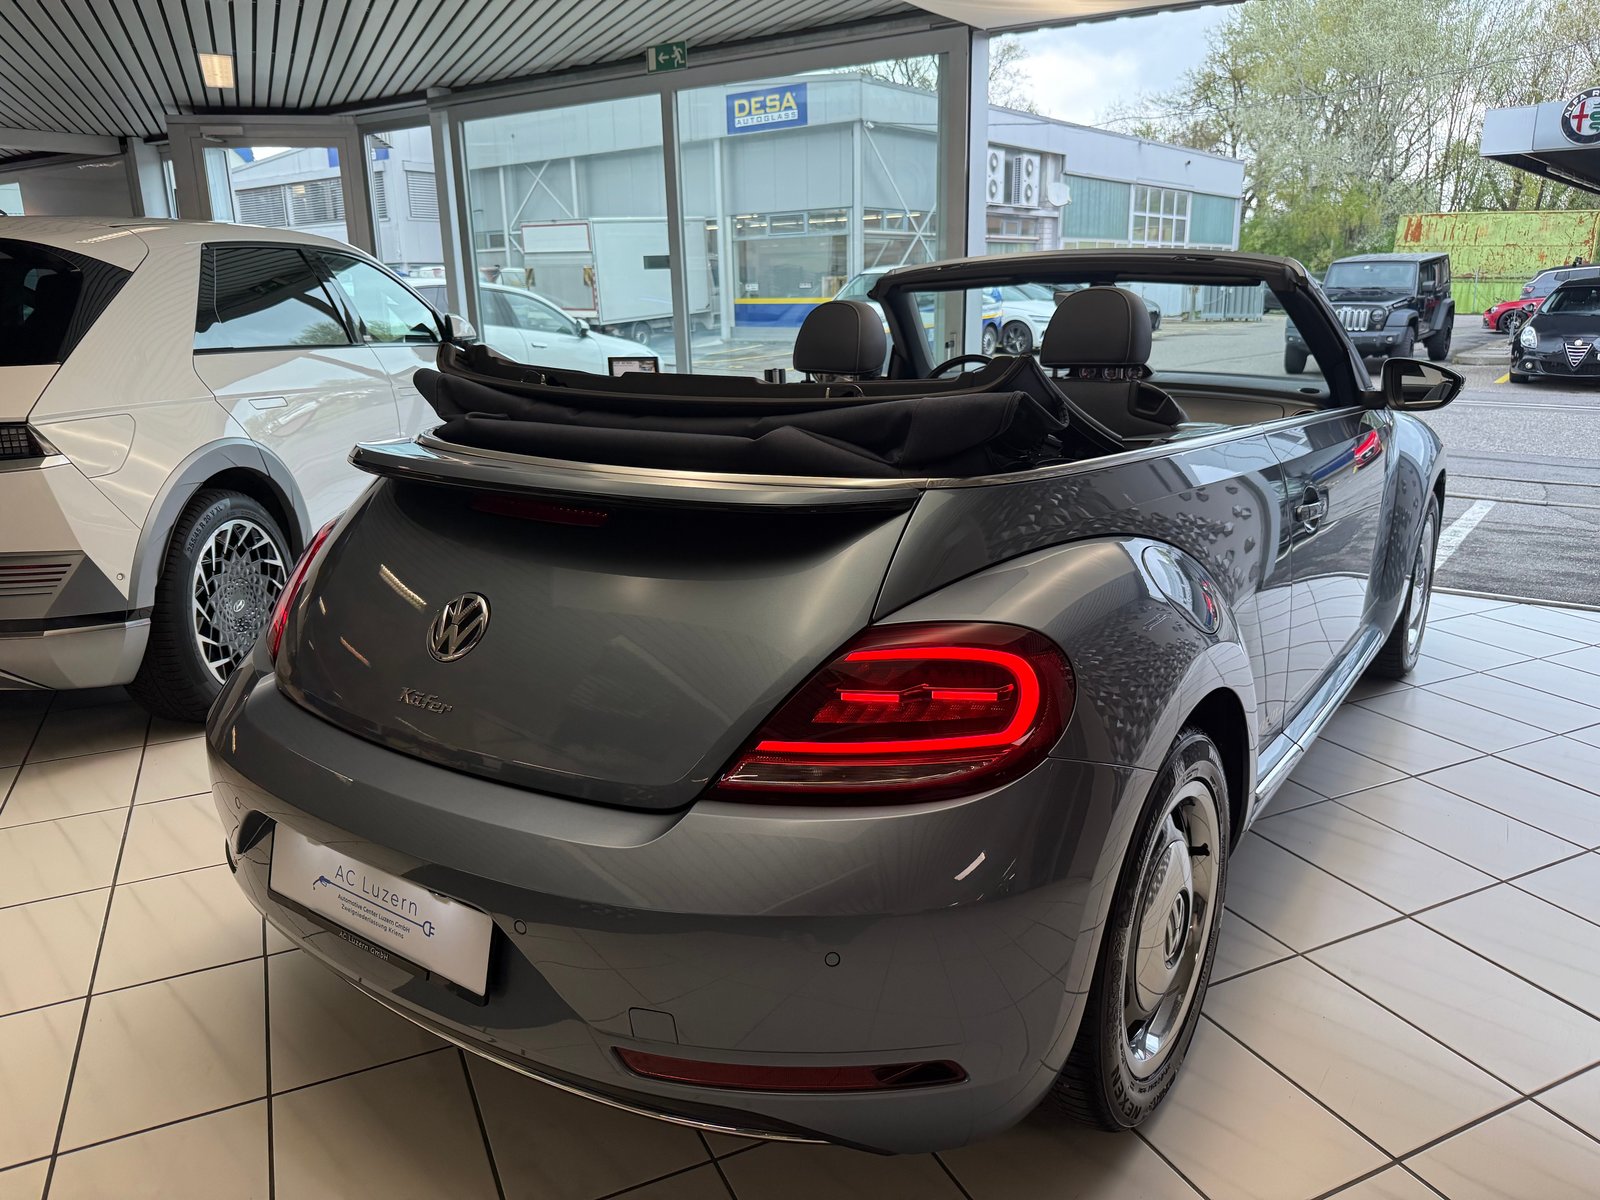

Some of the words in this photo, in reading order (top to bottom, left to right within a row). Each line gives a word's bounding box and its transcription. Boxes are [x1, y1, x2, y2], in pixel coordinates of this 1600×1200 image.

[734, 92, 797, 117] DESA
[736, 111, 796, 126] AUTOGLASS
[1564, 94, 1587, 119] ALFA
[187, 528, 202, 553] 255/45
[204, 514, 211, 523] 20
[399, 687, 453, 714] Käfer
[335, 865, 356, 887] AC
[362, 876, 418, 916] Luzern
[337, 894, 362, 911] Automotive
[363, 906, 378, 918] Center
[379, 913, 395, 926] Luzern
[395, 921, 411, 933] GmbH
[341, 904, 387, 932] Zweigniederlassung
[388, 926, 404, 939] Kriens
[338, 931, 347, 940] AC
[348, 935, 369, 951] Luzern
[370, 947, 389, 961] GmbH
[1111, 1064, 1142, 1120] NEXEN
